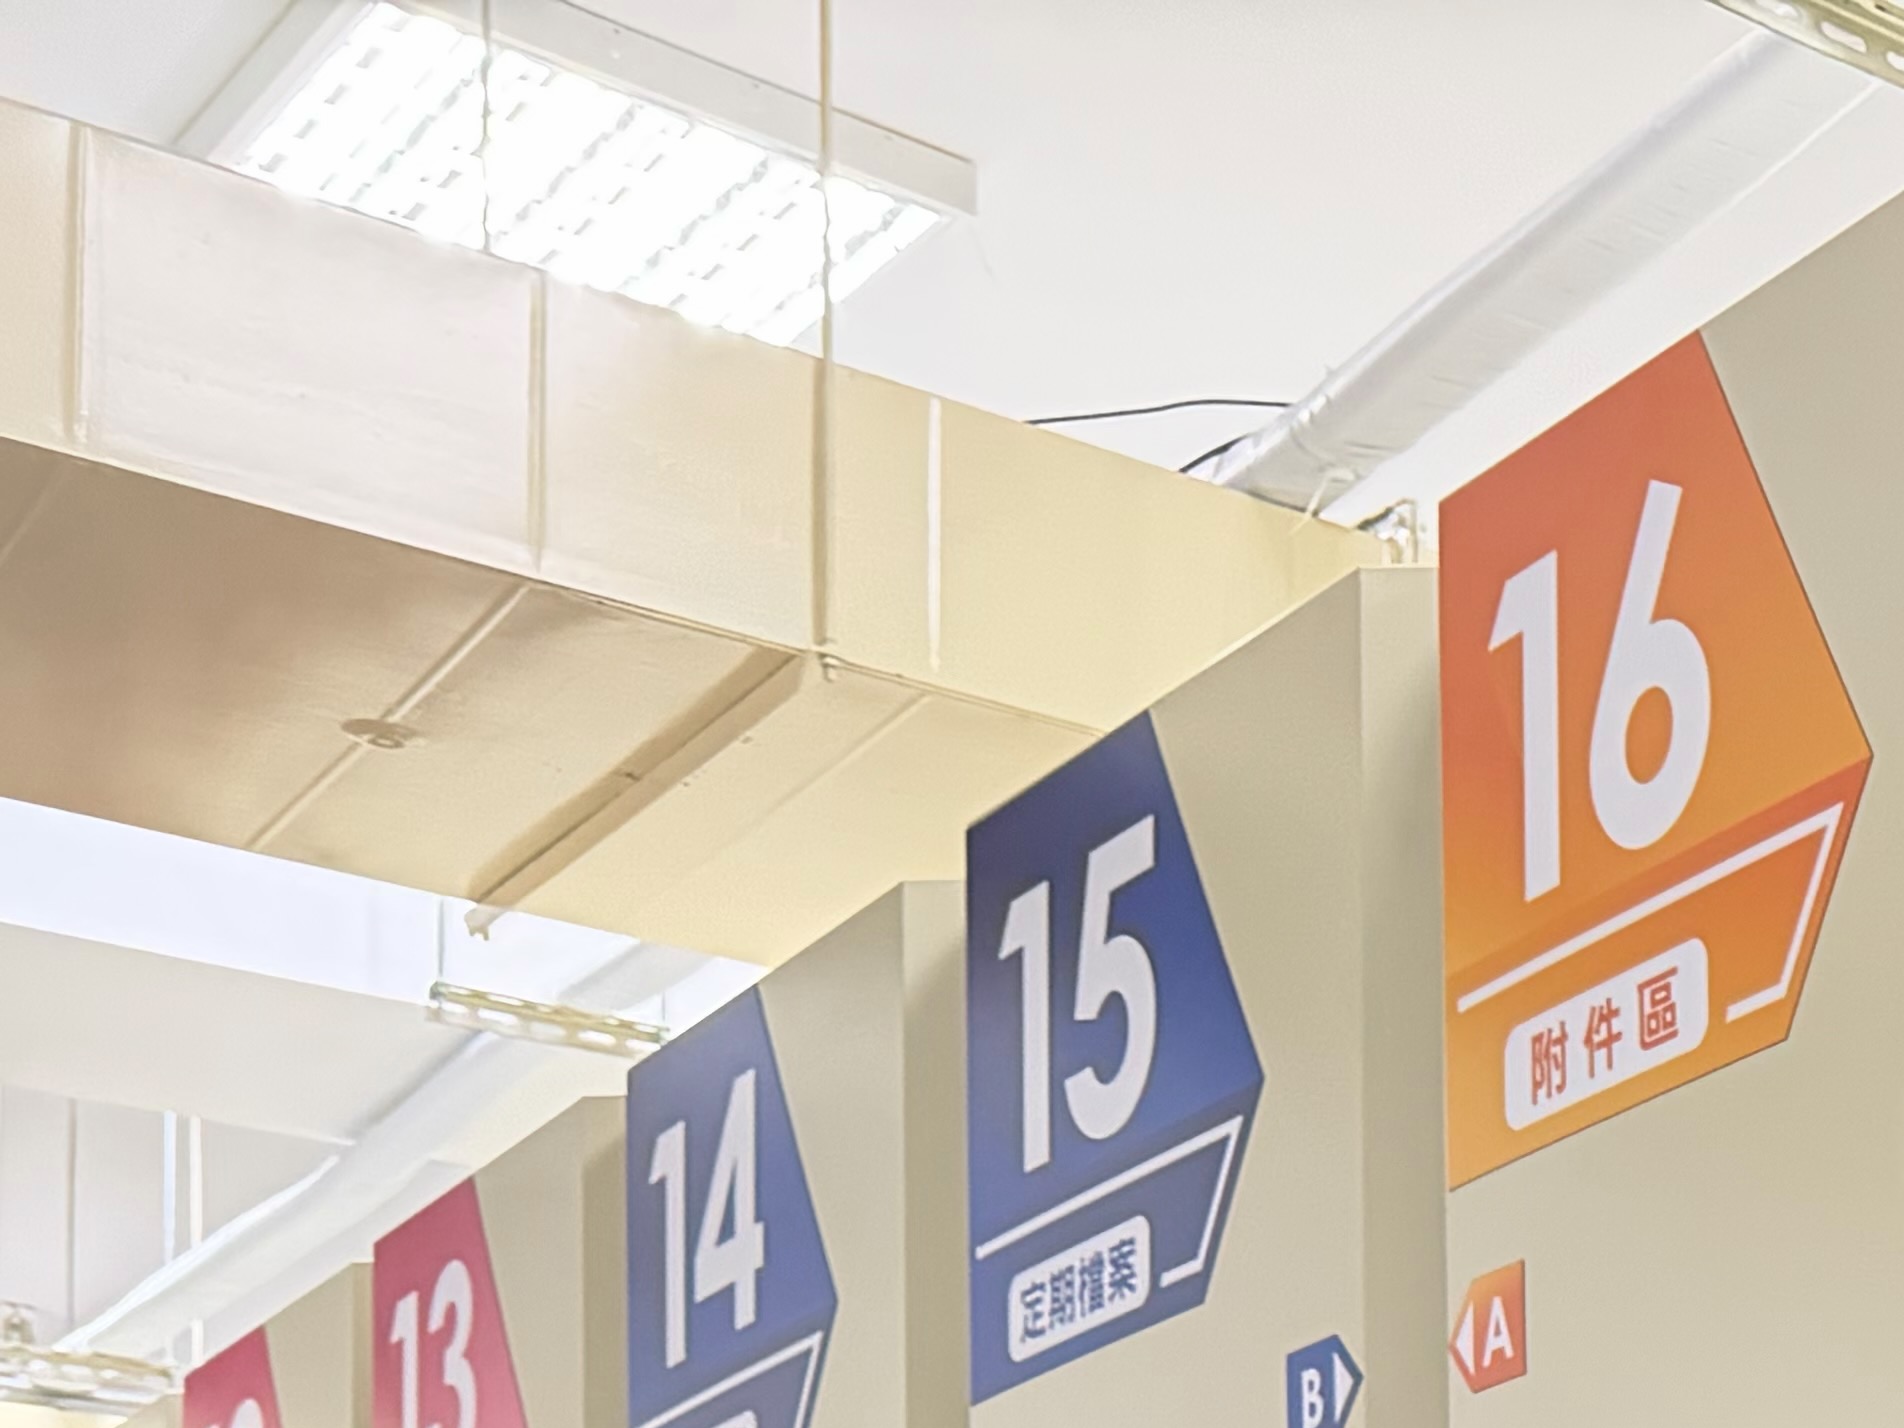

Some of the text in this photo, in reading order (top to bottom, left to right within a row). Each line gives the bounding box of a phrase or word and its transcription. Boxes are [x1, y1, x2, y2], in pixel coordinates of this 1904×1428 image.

[1487, 478, 1711, 903] 16
[998, 814, 1157, 1174] 15
[1529, 965, 1681, 1103] 附件區
[648, 1068, 763, 1369] 14
[1020, 1237, 1136, 1344] 定期檔案
[1482, 1296, 1513, 1369] A
